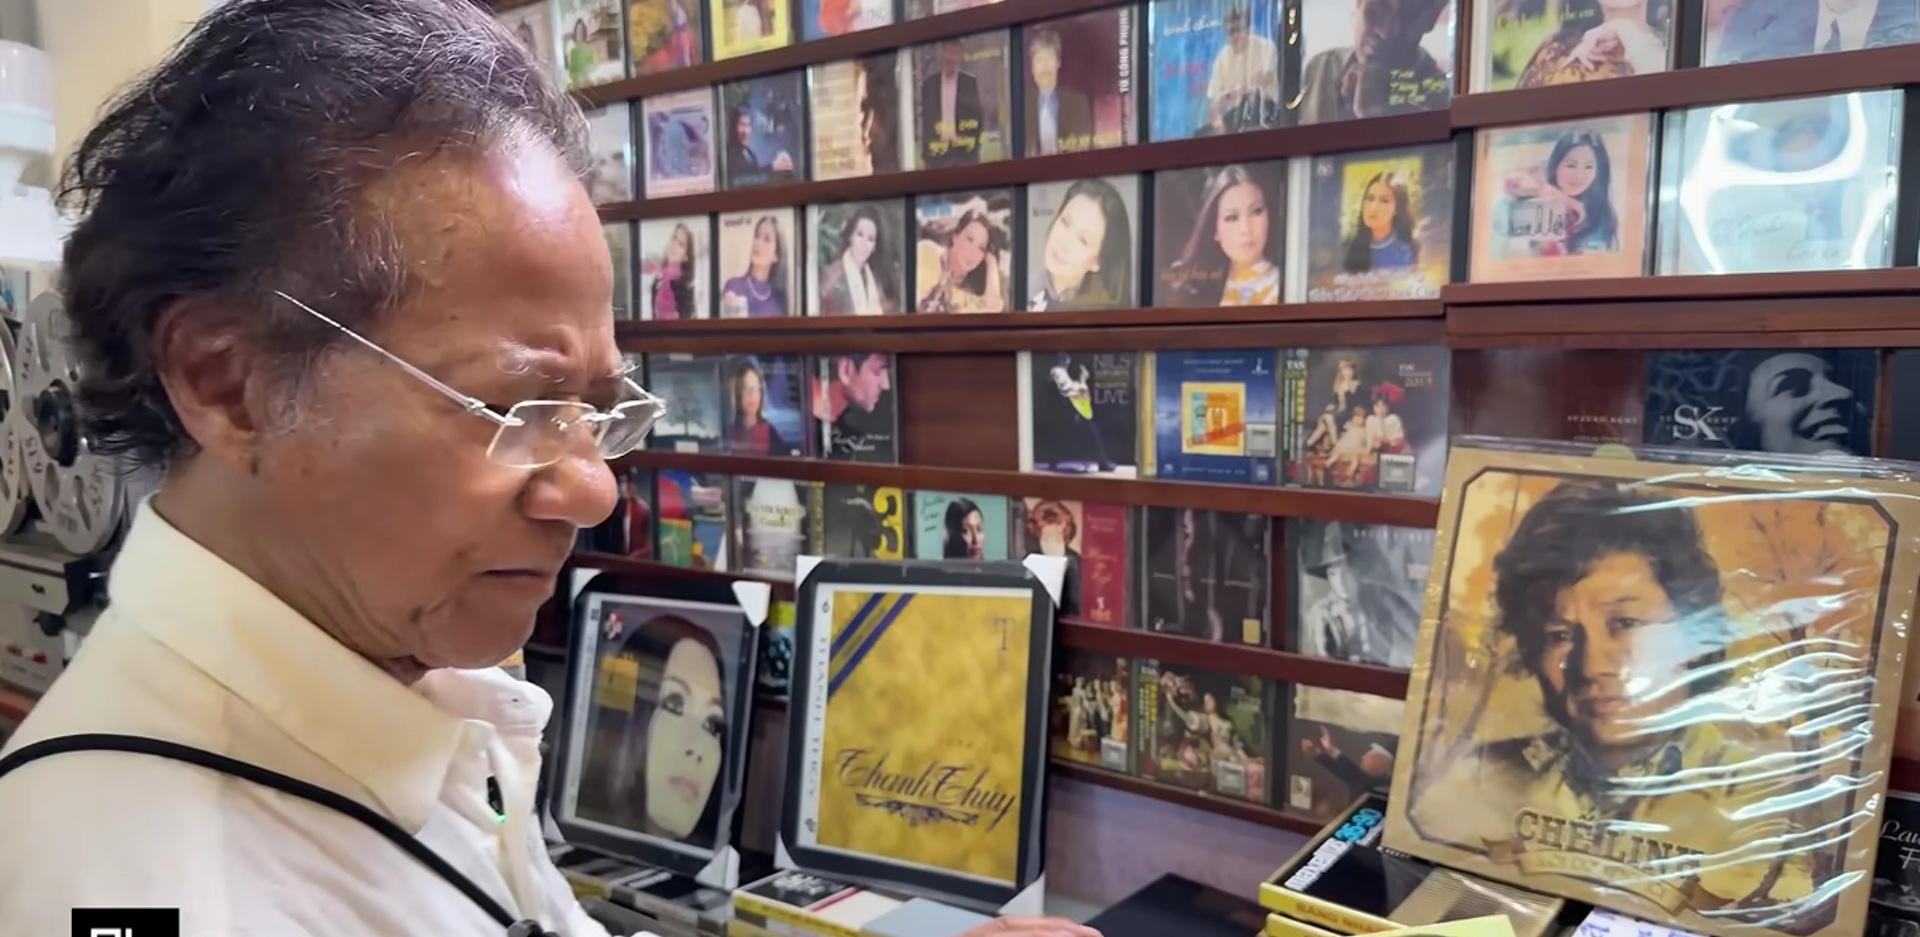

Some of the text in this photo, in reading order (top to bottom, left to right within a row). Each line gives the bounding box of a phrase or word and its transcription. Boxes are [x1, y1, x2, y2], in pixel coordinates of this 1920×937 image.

[1094, 389, 1129, 404] LIVE
[1672, 404, 1724, 441] SK
[836, 748, 937, 799] Thanh
